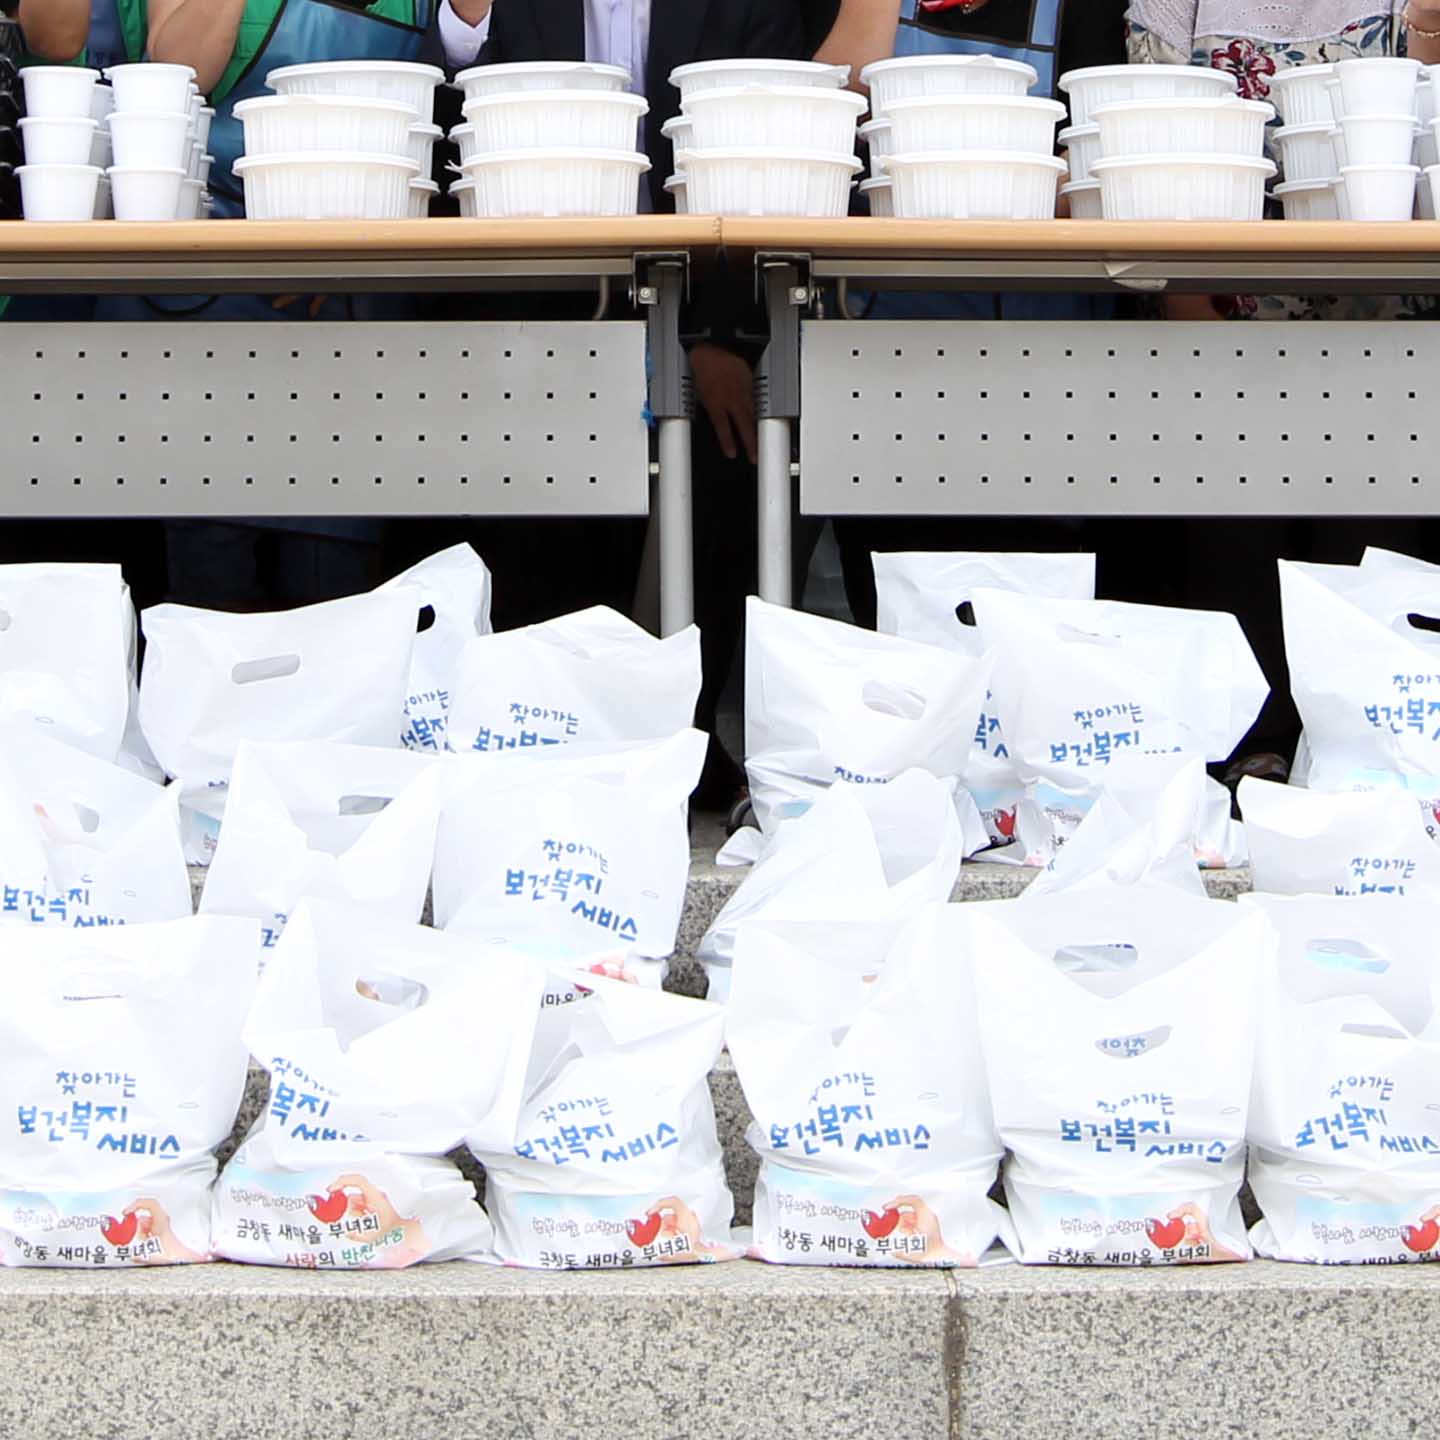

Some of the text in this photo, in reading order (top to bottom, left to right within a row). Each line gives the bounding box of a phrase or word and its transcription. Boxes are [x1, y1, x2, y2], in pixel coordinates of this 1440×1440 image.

[510, 703, 579, 735] 찾아가는
[1073, 702, 1144, 729] 찾아가는
[1049, 731, 1140, 766] 보건복지
[542, 839, 608, 874] 찾아가는
[1350, 857, 1416, 879] 찾아가는
[506, 868, 638, 941] 보건복지 서비스
[56, 1070, 136, 1098] 찾아가는
[536, 1096, 611, 1123] 찾아가는
[1295, 1101, 1388, 1150] 보건복지
[18, 1101, 181, 1159] 보건복지 서비스
[514, 1122, 678, 1166] 보건복지 서비스
[770, 1104, 931, 1155] 보건복지 서비스
[1060, 1117, 1227, 1163] 보건복지 서비스
[237, 1215, 379, 1245] 금창동 새마을 부녀회
[820, 1234, 870, 1257] 새마을
[876, 1236, 927, 1255] 부녀회
[56, 1244, 109, 1264] 새마을
[115, 1238, 162, 1260] 부녀회
[286, 1228, 404, 1268] 사랑의 반찬나눔
[585, 1251, 636, 1266] 새마을
[642, 1236, 690, 1259] 부녀회
[1048, 1245, 1210, 1266] 금창동 새마을 부녀회
